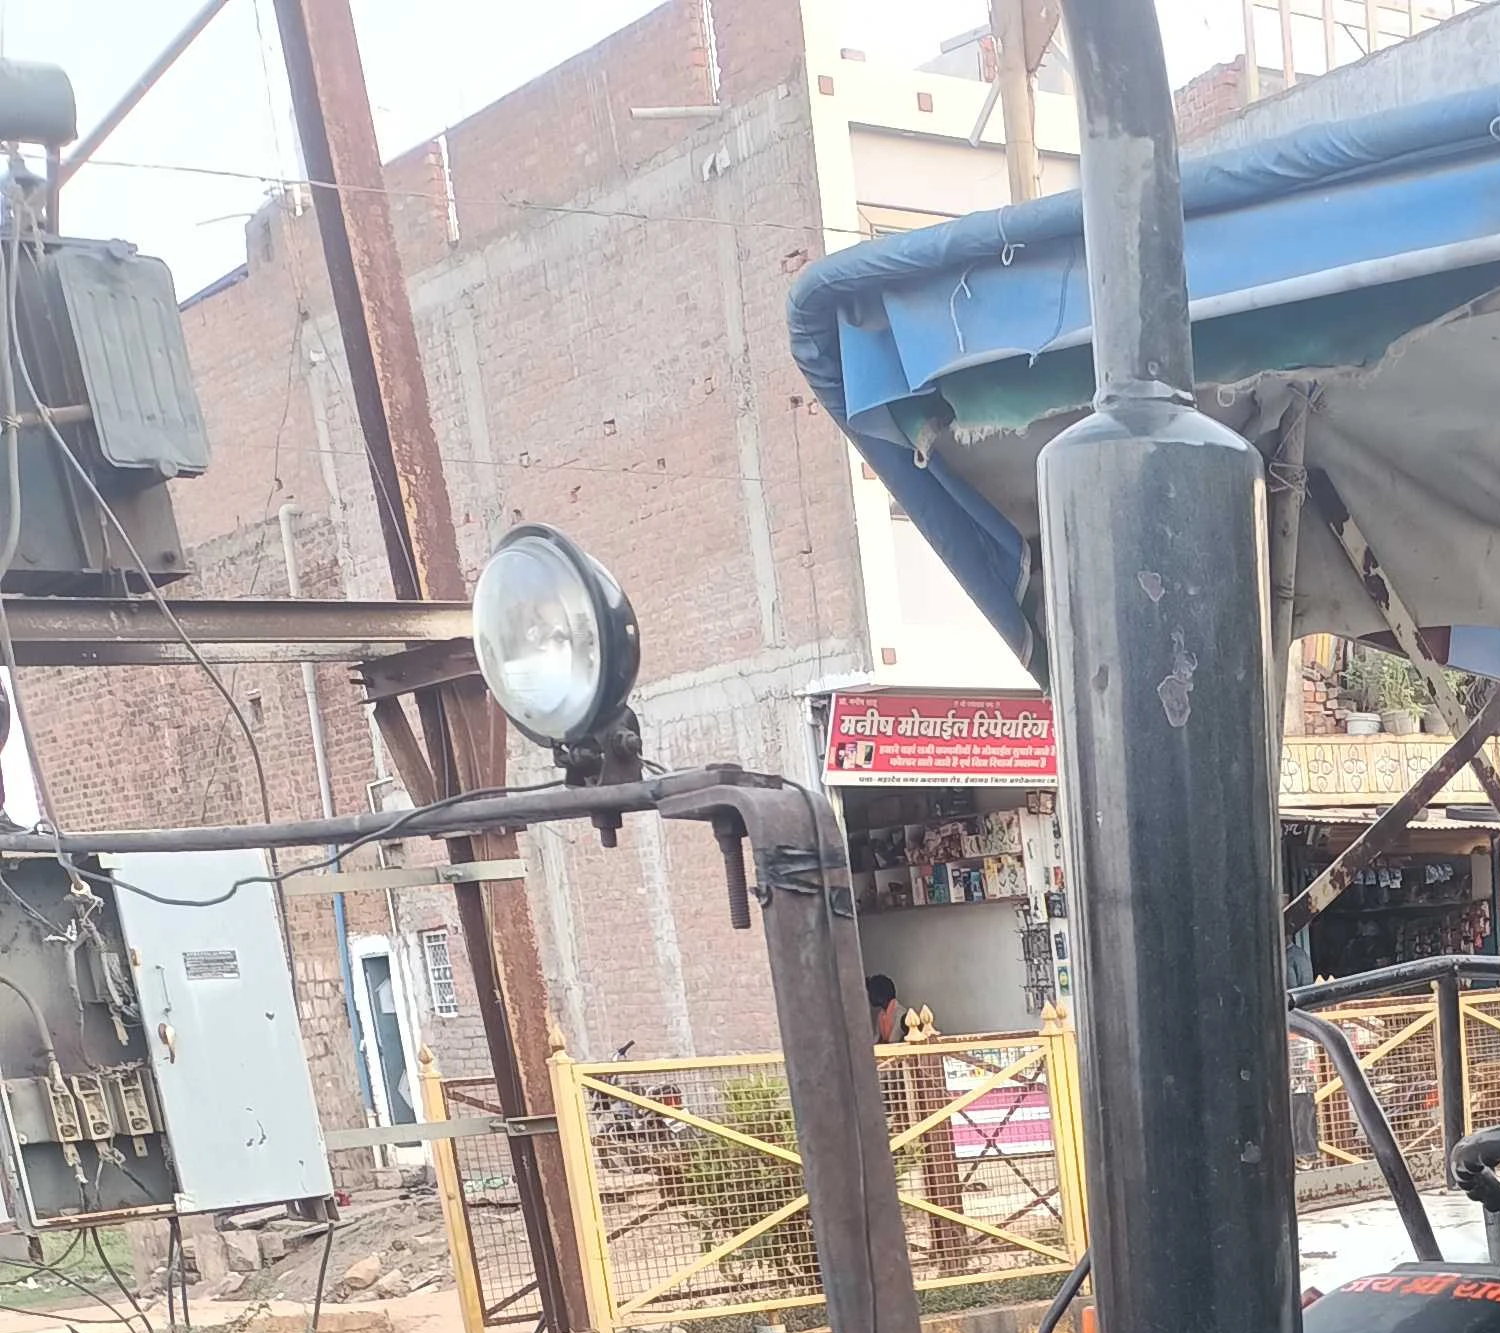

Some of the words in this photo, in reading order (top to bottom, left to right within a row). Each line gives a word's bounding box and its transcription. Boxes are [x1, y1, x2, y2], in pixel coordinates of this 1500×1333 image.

[840, 708, 895, 736] मनीष
[898, 708, 970, 740] मोबाईल
[972, 710, 1050, 738] रिपेयरिंग
